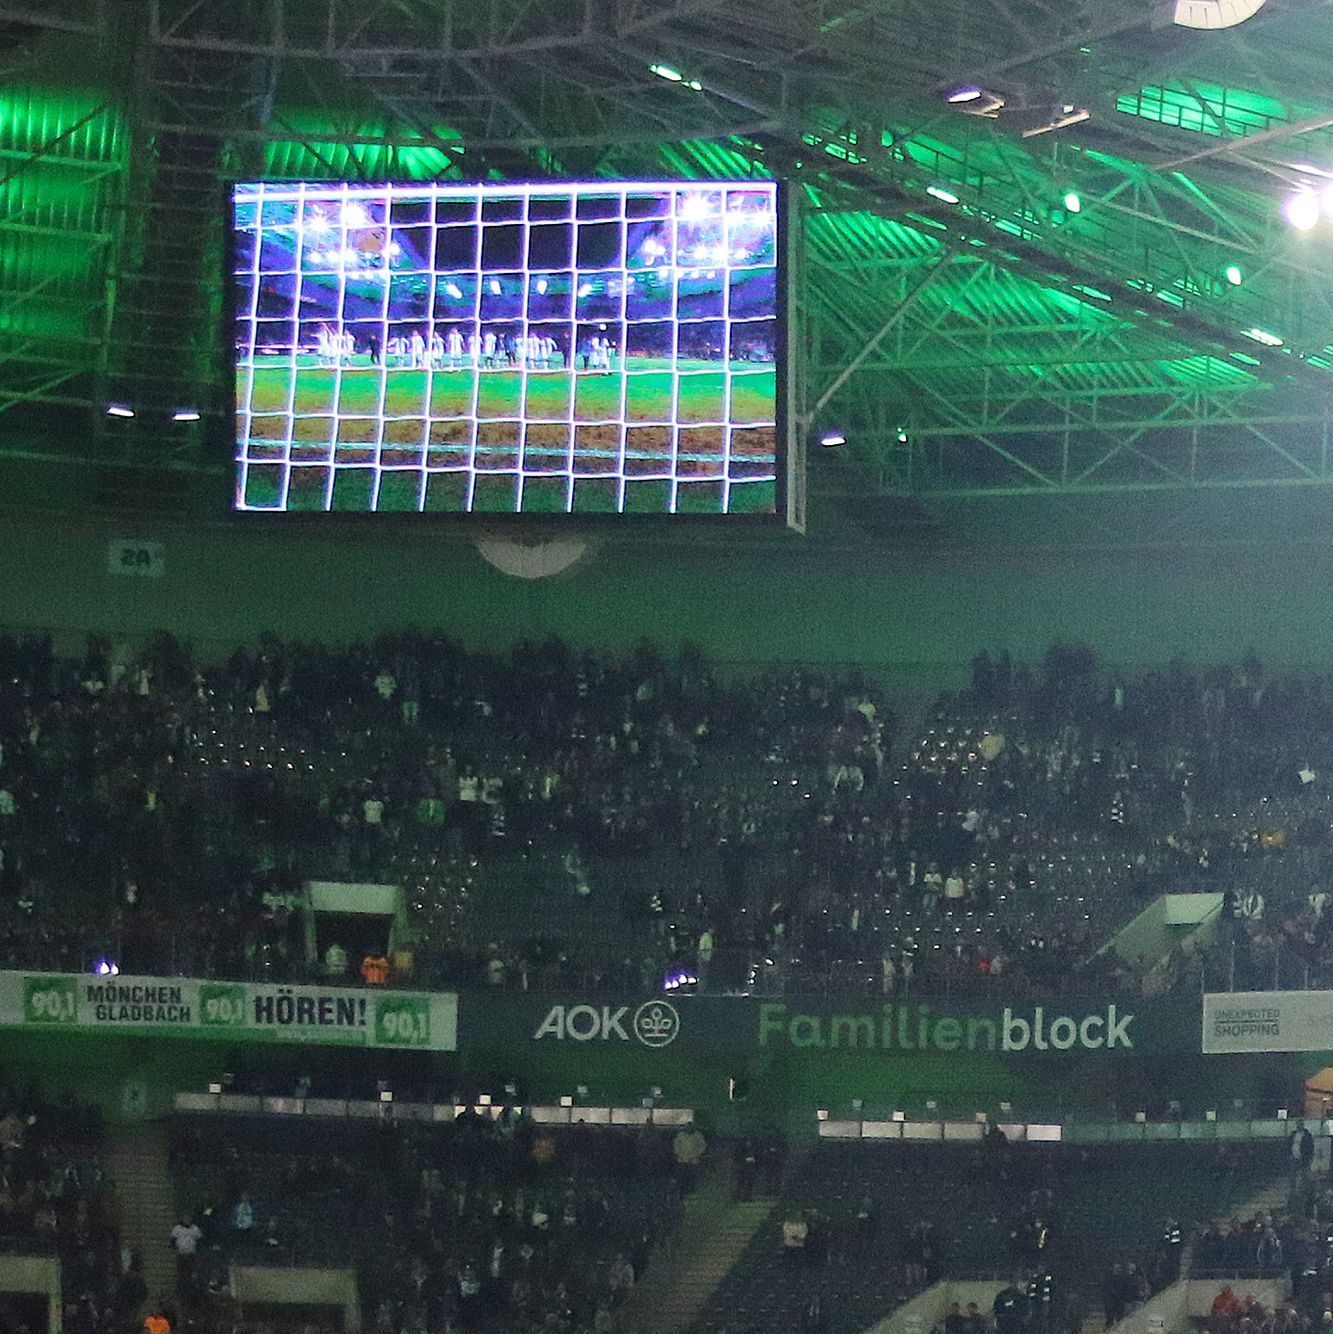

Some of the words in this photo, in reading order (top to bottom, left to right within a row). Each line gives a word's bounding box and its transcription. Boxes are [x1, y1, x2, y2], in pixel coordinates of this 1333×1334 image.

[86, 980, 183, 1003] MÖNCHEN
[95, 1004, 192, 1023] GLADBACH
[254, 988, 368, 1028] HÖREN!
[1214, 1008, 1280, 1021] UNEXPECTED
[534, 1004, 630, 1042] AOK
[758, 1003, 1135, 1052] Familienblock
[1214, 1023, 1280, 1037] SHOPPING
